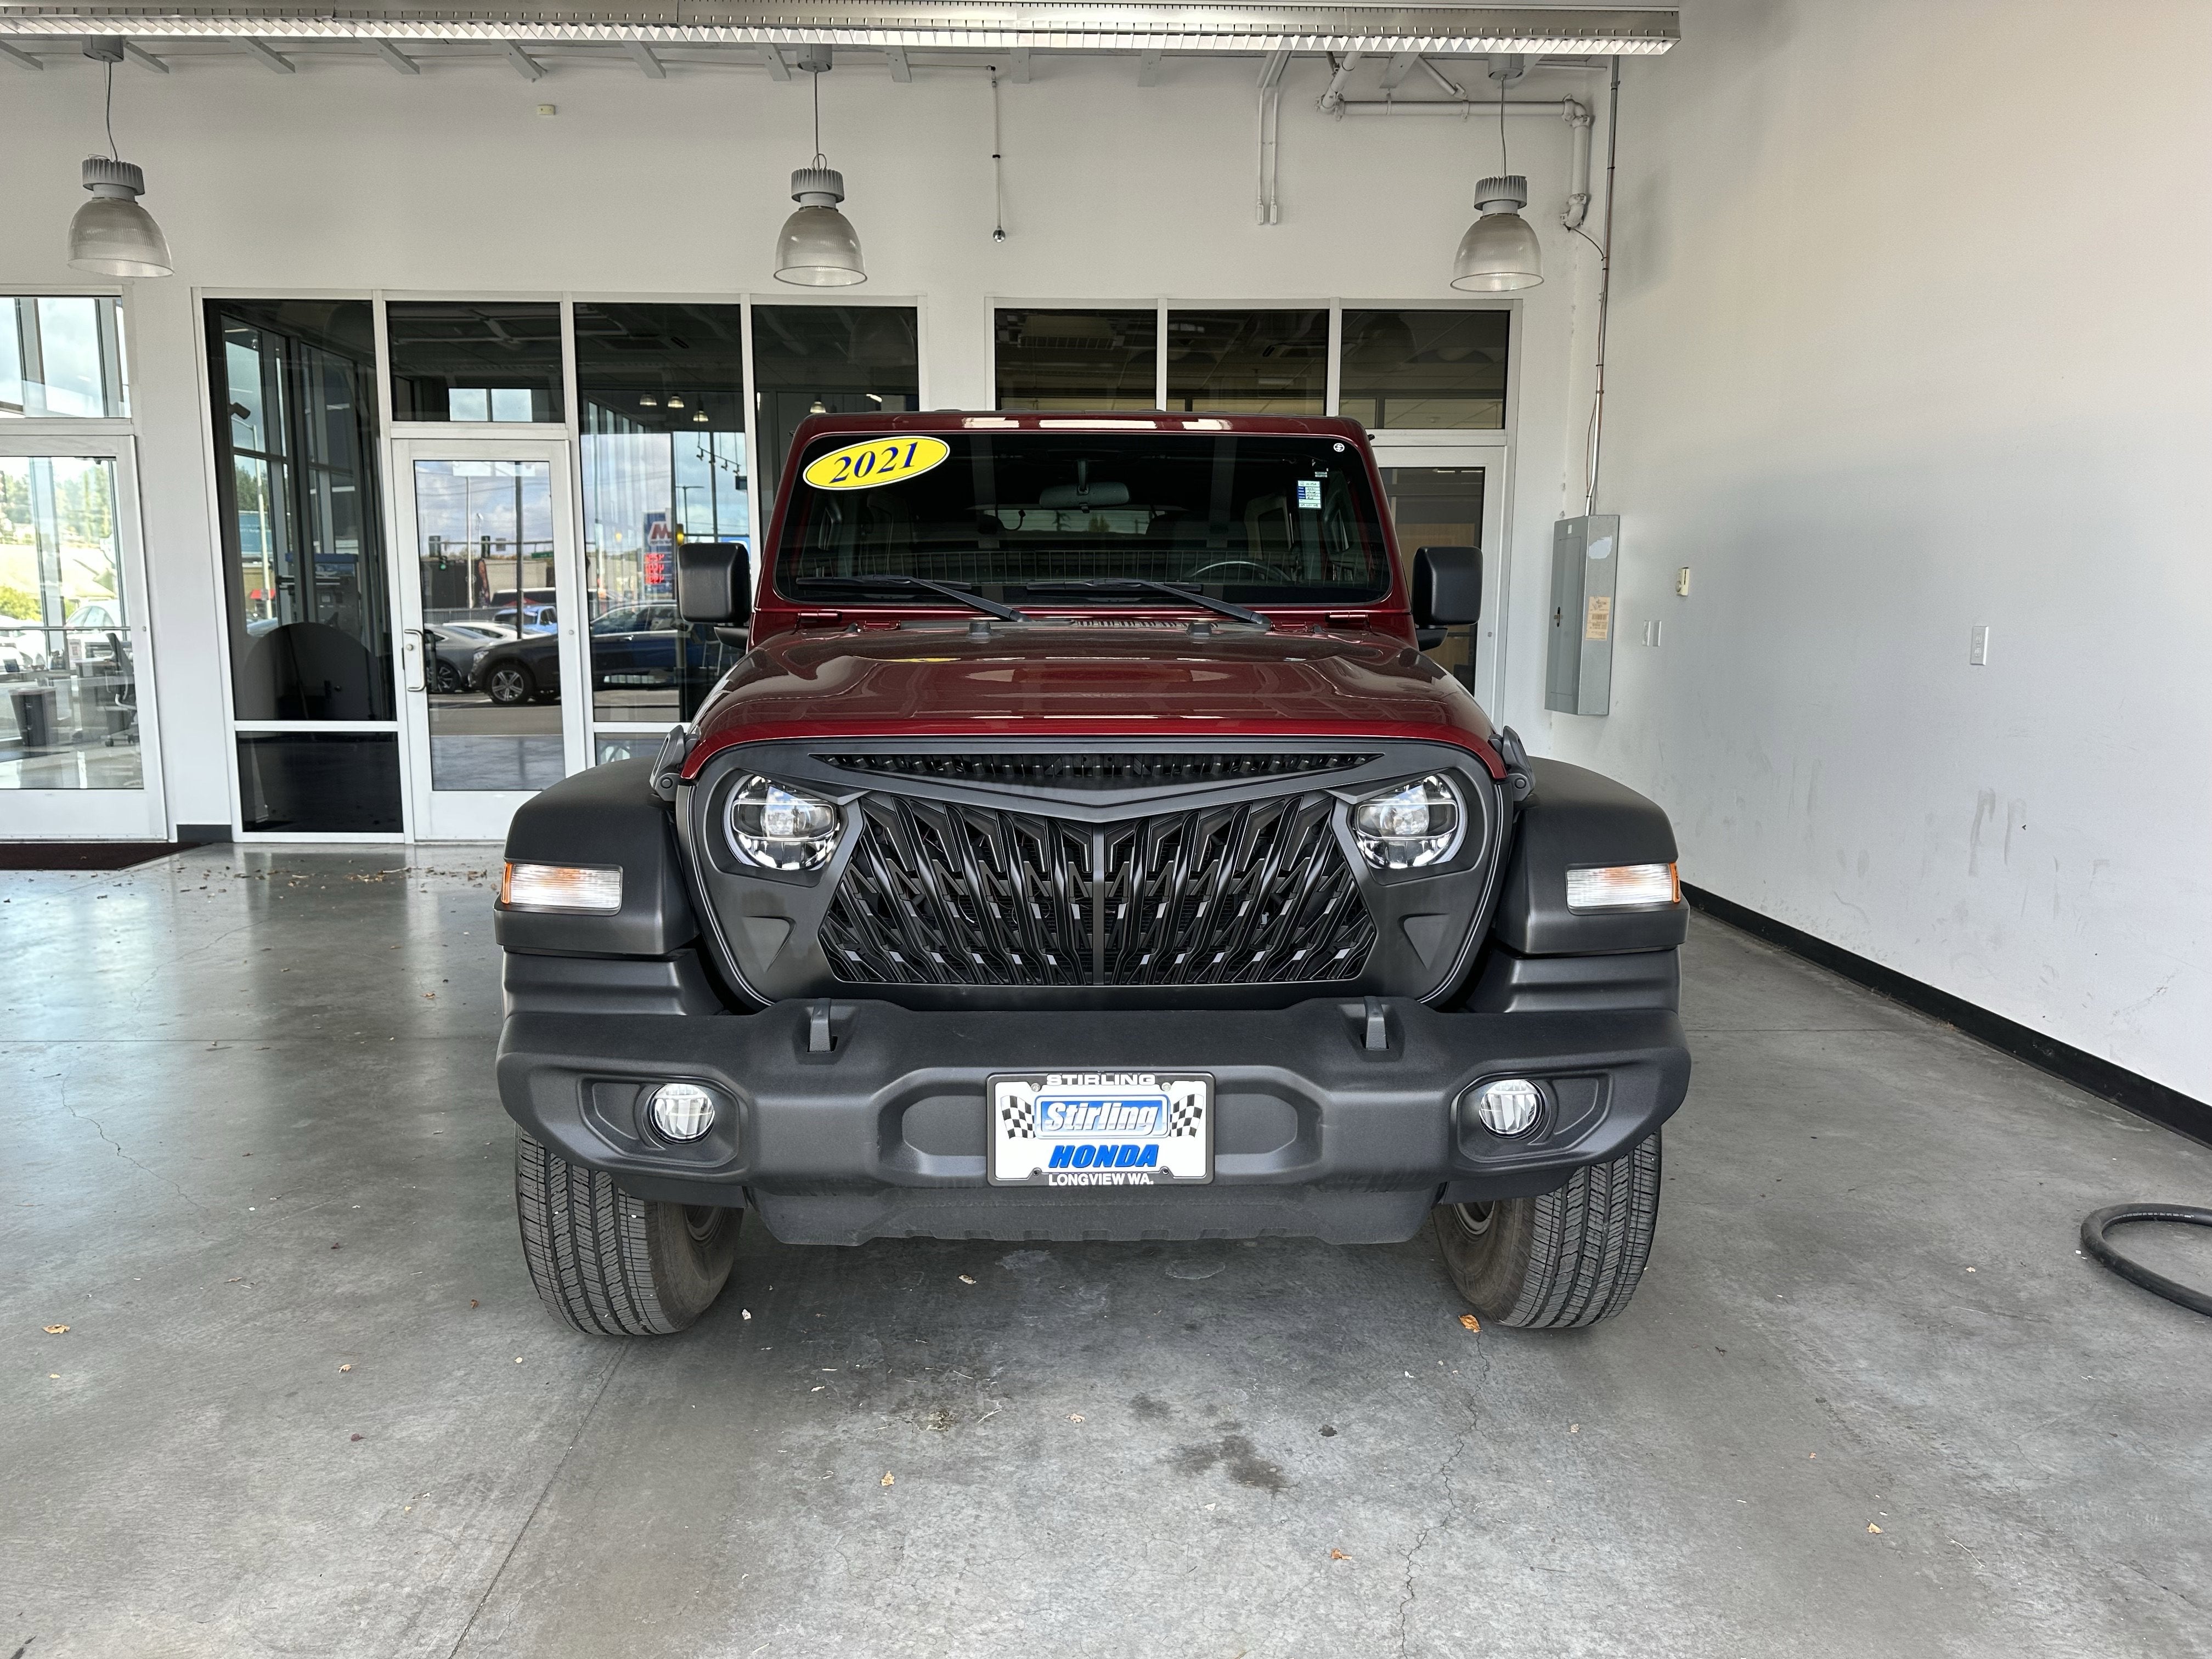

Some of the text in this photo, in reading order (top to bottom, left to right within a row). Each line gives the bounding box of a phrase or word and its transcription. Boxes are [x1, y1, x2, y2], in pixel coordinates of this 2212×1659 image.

[828, 441, 918, 484] 2021
[1046, 1073, 1155, 1086] STIRLING
[1045, 1102, 1159, 1136] Stirling
[1048, 1144, 1159, 1168] HONDA
[1048, 1173, 1154, 1186] LONGVIEW WA.
